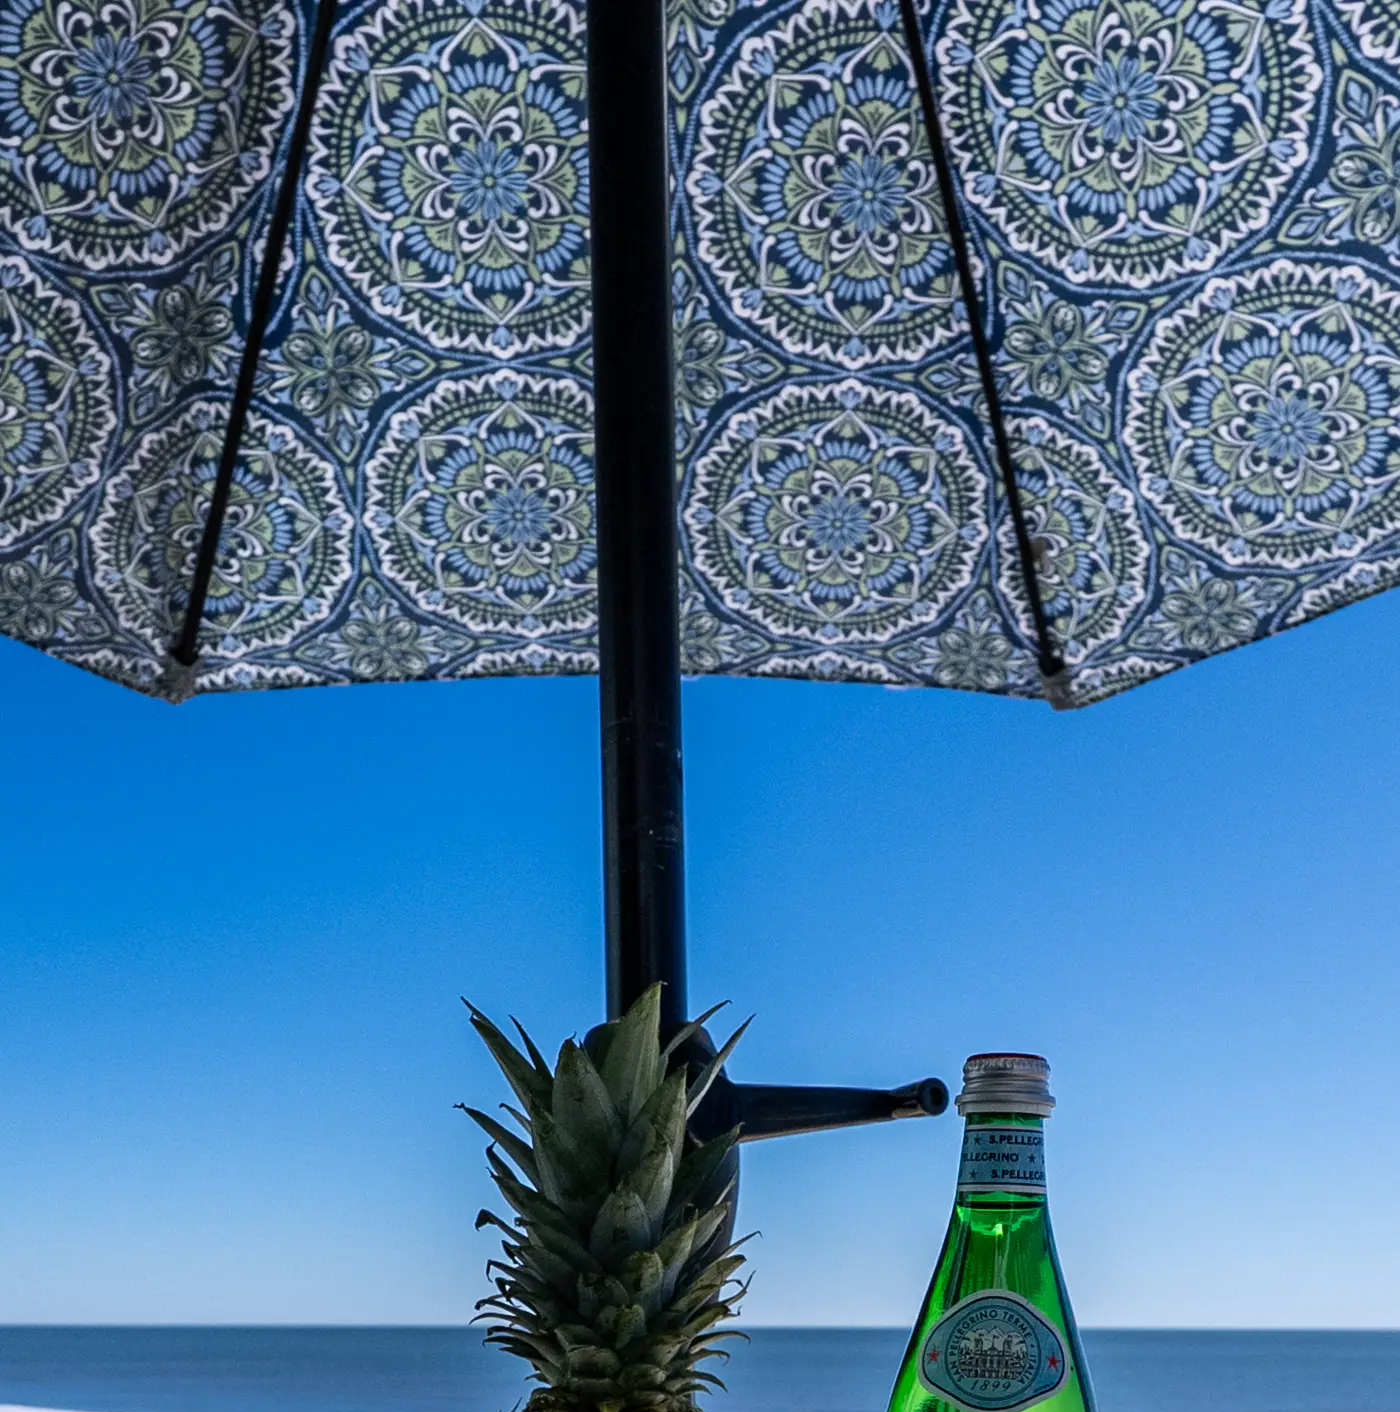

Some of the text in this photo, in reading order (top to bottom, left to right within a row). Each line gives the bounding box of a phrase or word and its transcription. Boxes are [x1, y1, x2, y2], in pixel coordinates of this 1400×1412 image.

[949, 1309, 1032, 1383] SAN PELLEGRINO TERME
[970, 1379, 1012, 1392] 1899
